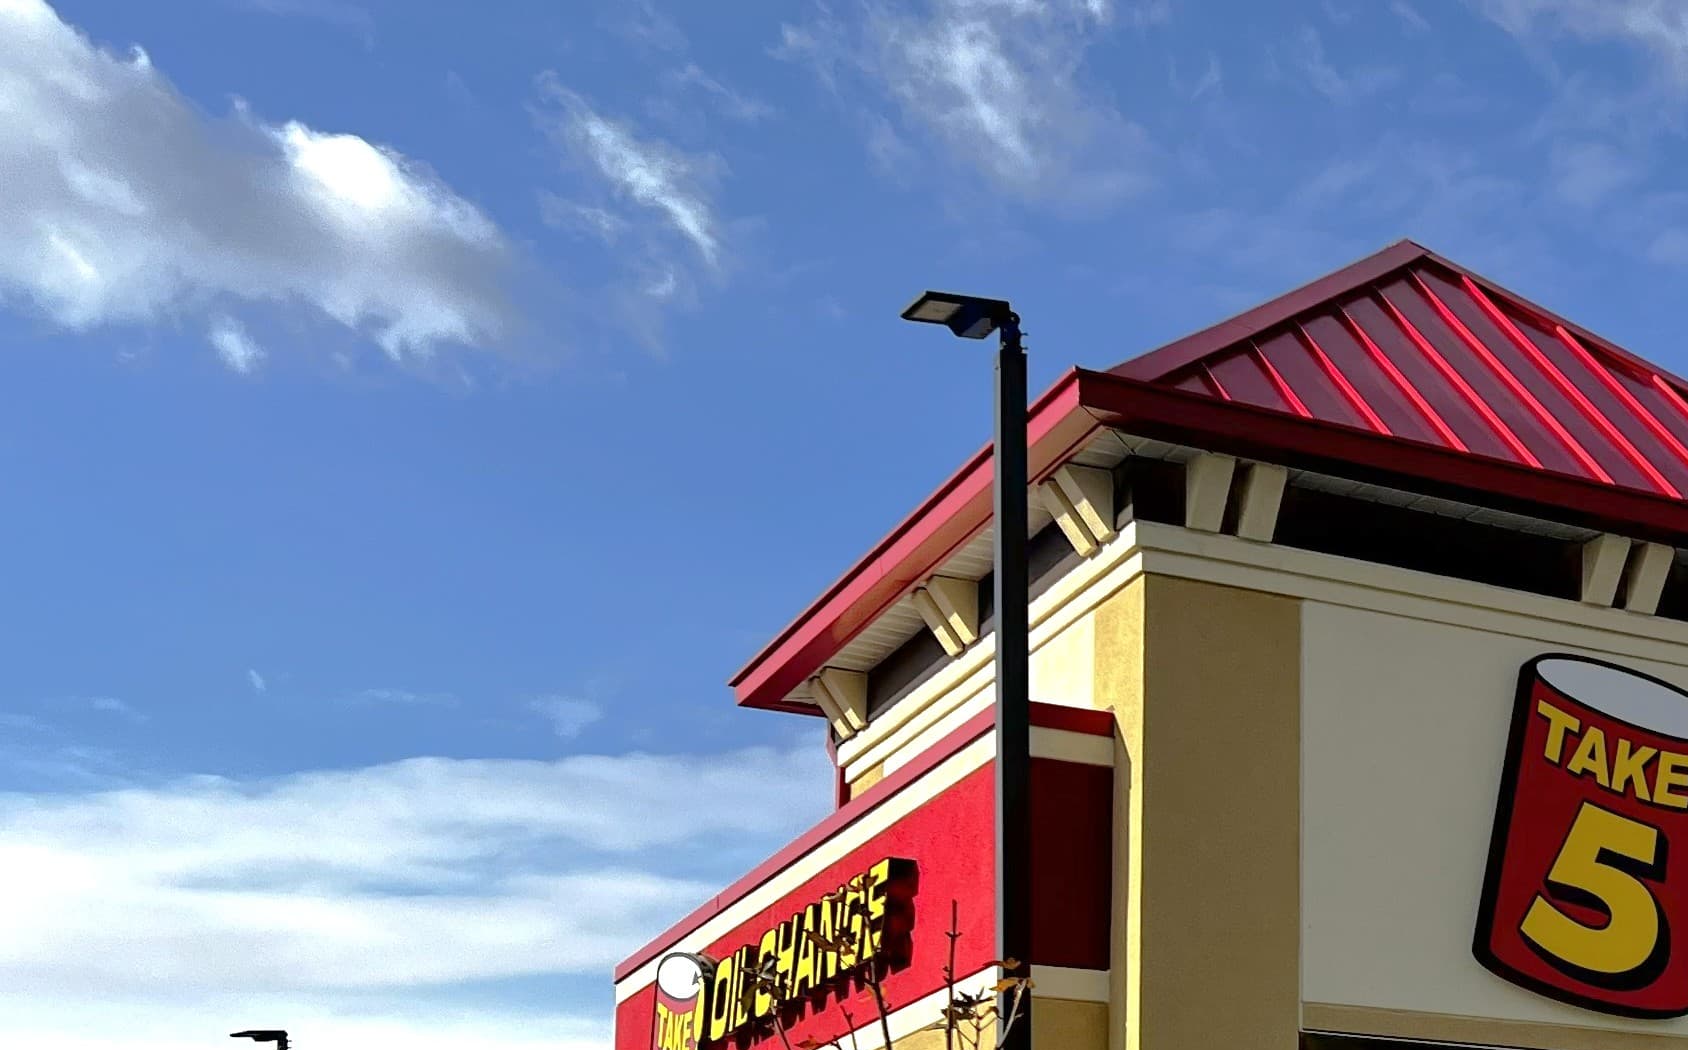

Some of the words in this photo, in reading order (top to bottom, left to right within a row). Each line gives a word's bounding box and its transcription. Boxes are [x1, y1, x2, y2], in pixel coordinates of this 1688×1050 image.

[711, 943, 748, 1041] OIL
[754, 858, 891, 1018] CHANGE
[1520, 802, 1660, 973] 5
